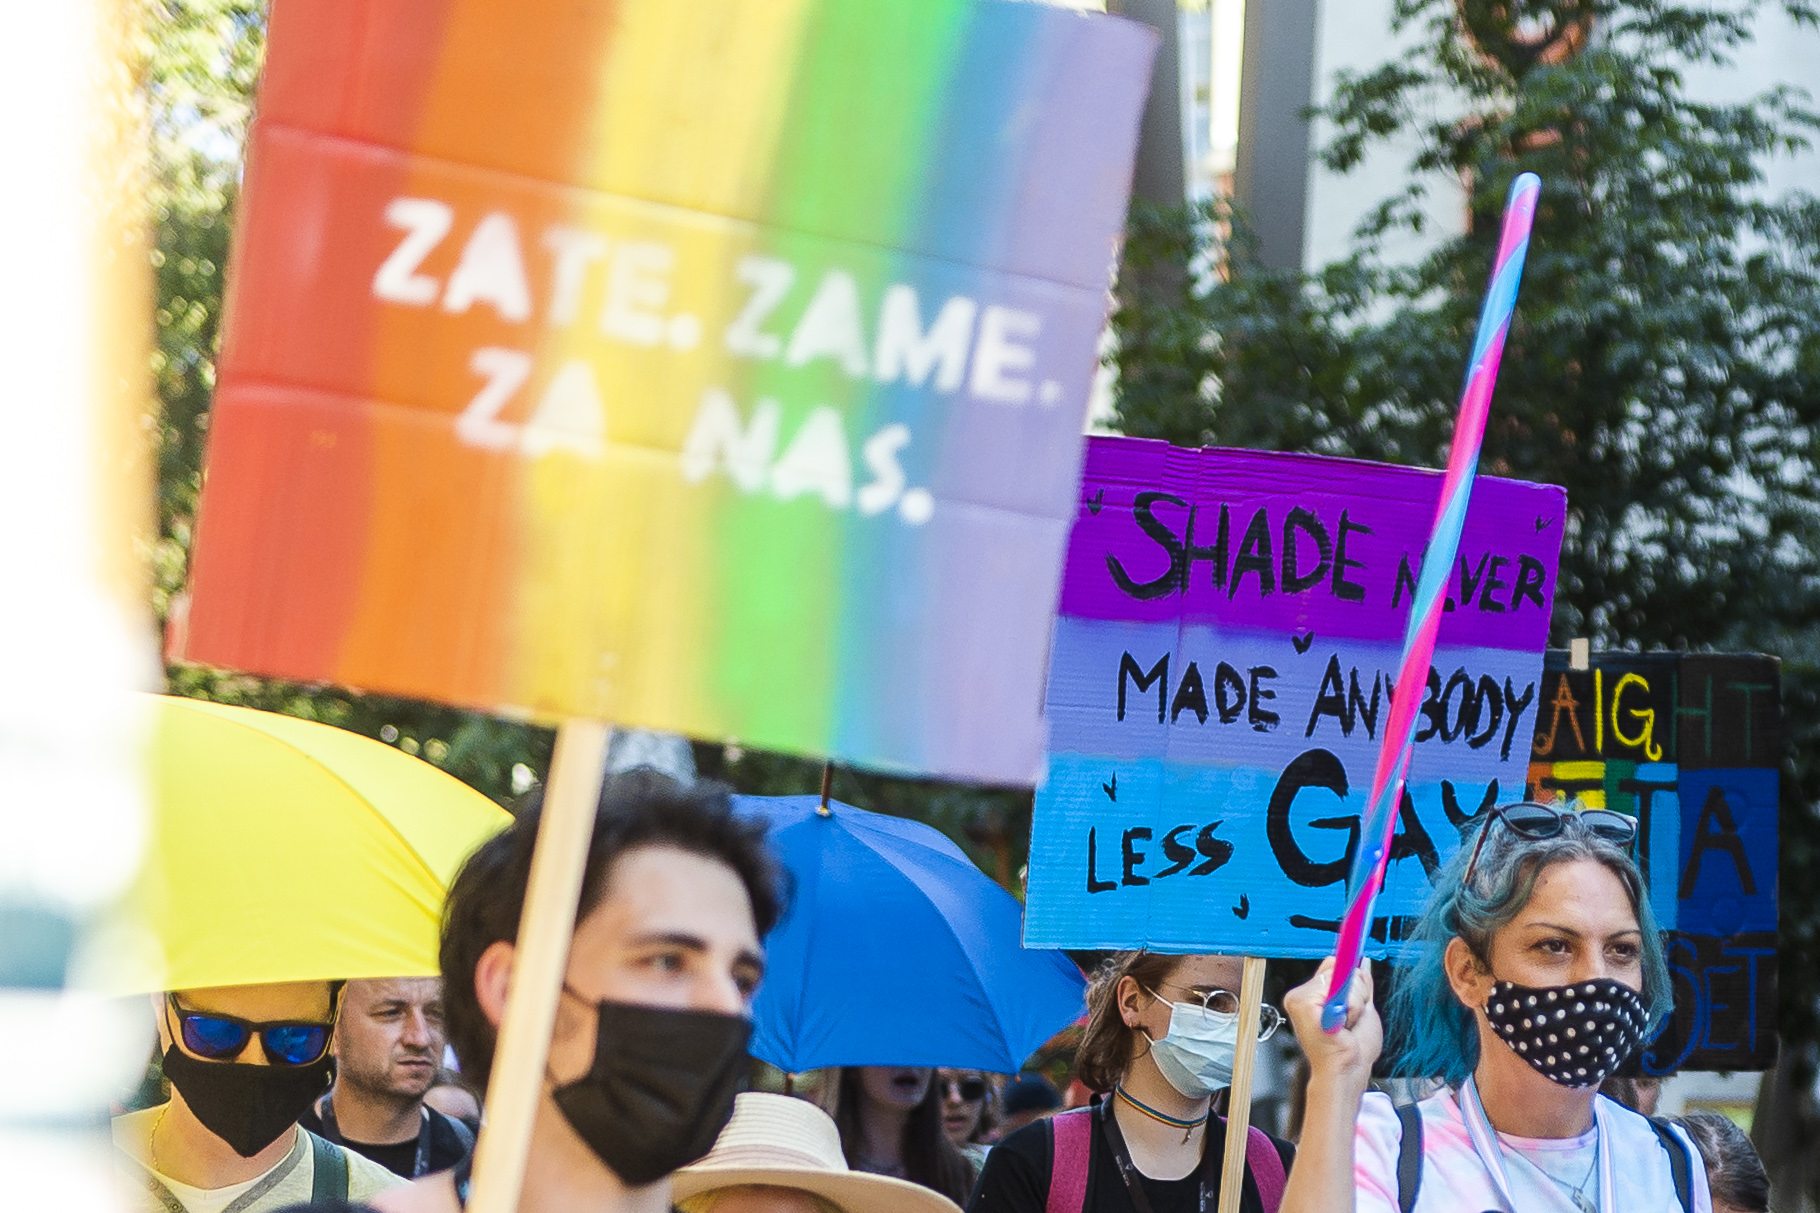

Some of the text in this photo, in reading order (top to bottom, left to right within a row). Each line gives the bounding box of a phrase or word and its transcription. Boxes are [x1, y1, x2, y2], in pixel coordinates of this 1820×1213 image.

[370, 196, 1063, 408] ZATE. ZAME.
[454, 347, 934, 525] ZA NAS.
[1106, 491, 1547, 614] SHADE NVER
[1116, 650, 1280, 733] MADE
[1087, 819, 1235, 894] LESS
